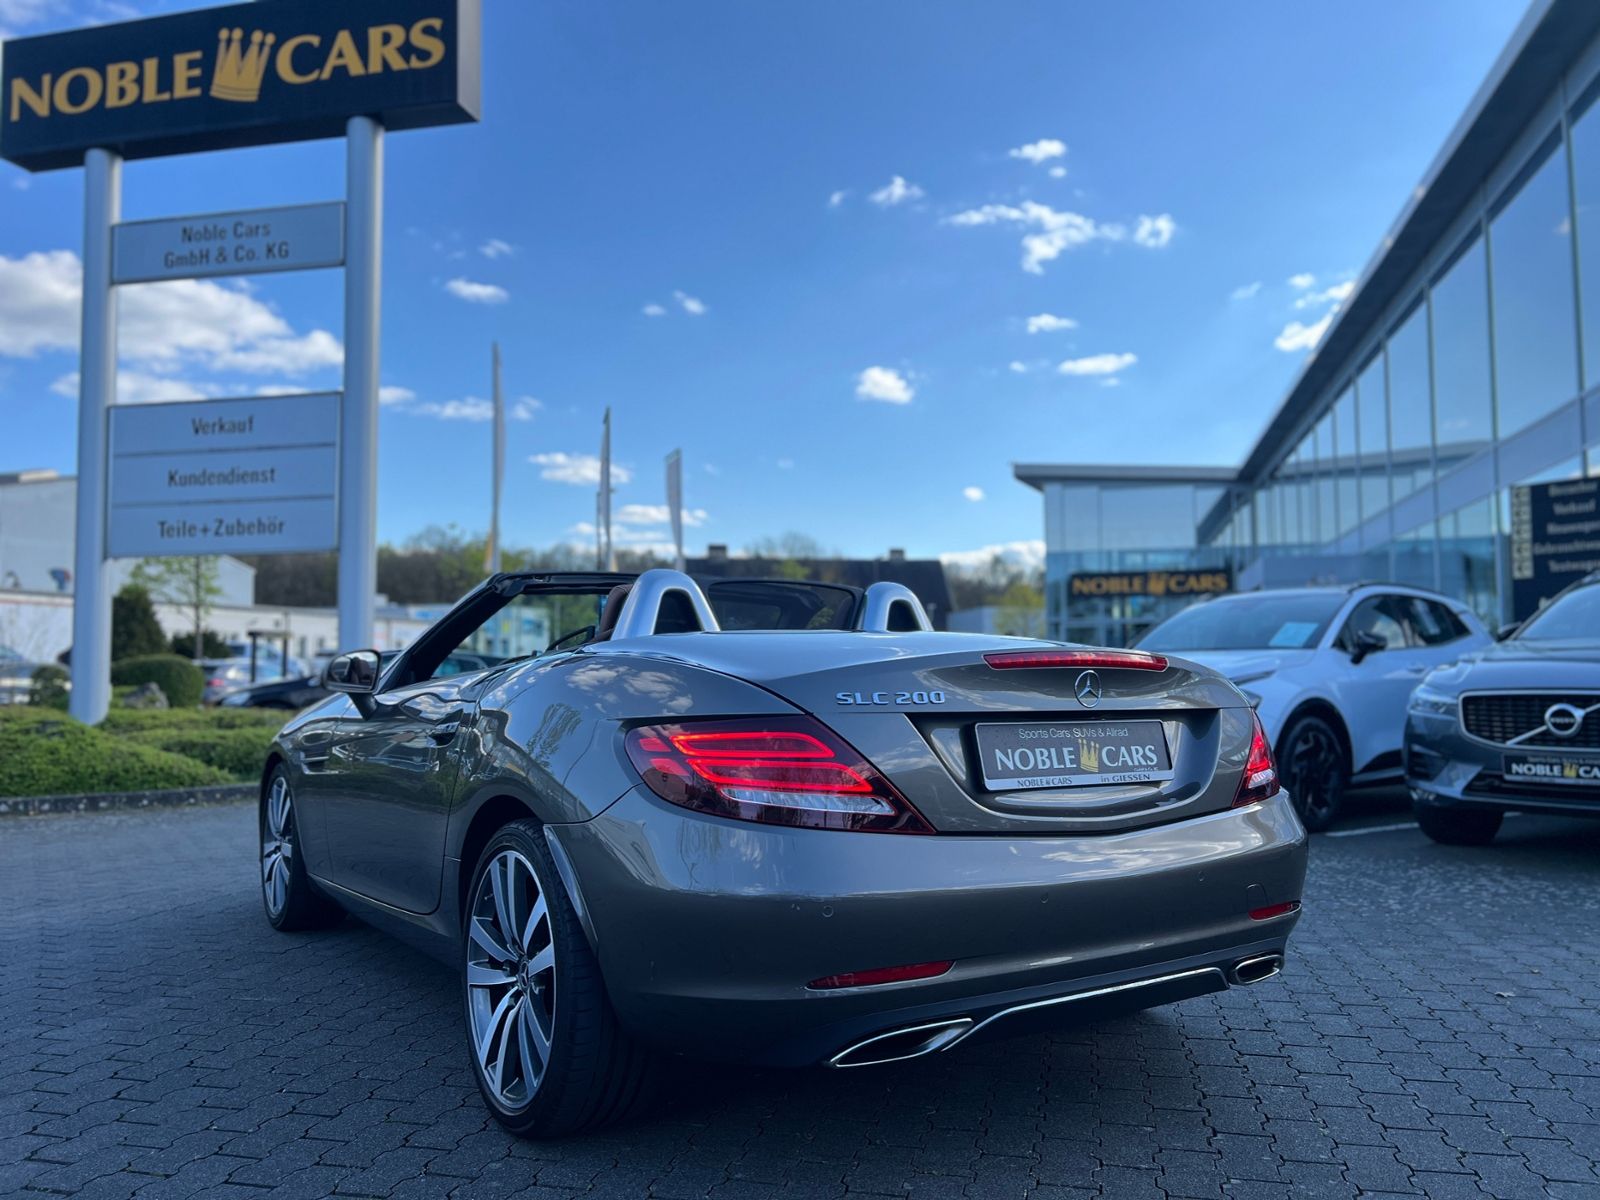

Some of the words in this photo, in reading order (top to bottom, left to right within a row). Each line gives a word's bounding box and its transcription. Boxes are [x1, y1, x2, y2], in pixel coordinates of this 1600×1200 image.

[10, 51, 203, 122] NOBLE
[275, 18, 446, 85] CARS
[181, 223, 227, 243] Noble
[233, 221, 270, 239] Cars
[164, 248, 210, 269] GmbH
[215, 247, 227, 264] &
[234, 245, 260, 263] Co.
[266, 241, 290, 260] KG
[192, 415, 254, 436] Verkauf
[168, 467, 276, 488] Kundendienst
[1072, 576, 1143, 595] NOBLE
[1169, 573, 1228, 592] CARS
[836, 692, 889, 705] SLC
[895, 690, 946, 705] 200
[1018, 728, 1049, 740] Sports
[1098, 727, 1104, 737] &
[1106, 726, 1129, 737] Allrad
[995, 747, 1077, 771] NOBLE
[1101, 745, 1158, 767] CARS
[1101, 774, 1110, 783] in
[1112, 773, 1151, 782] GIESSEN
[1511, 762, 1562, 777] NOBLE
[1017, 778, 1045, 788] NOBLE
[1052, 776, 1073, 786] CARS
